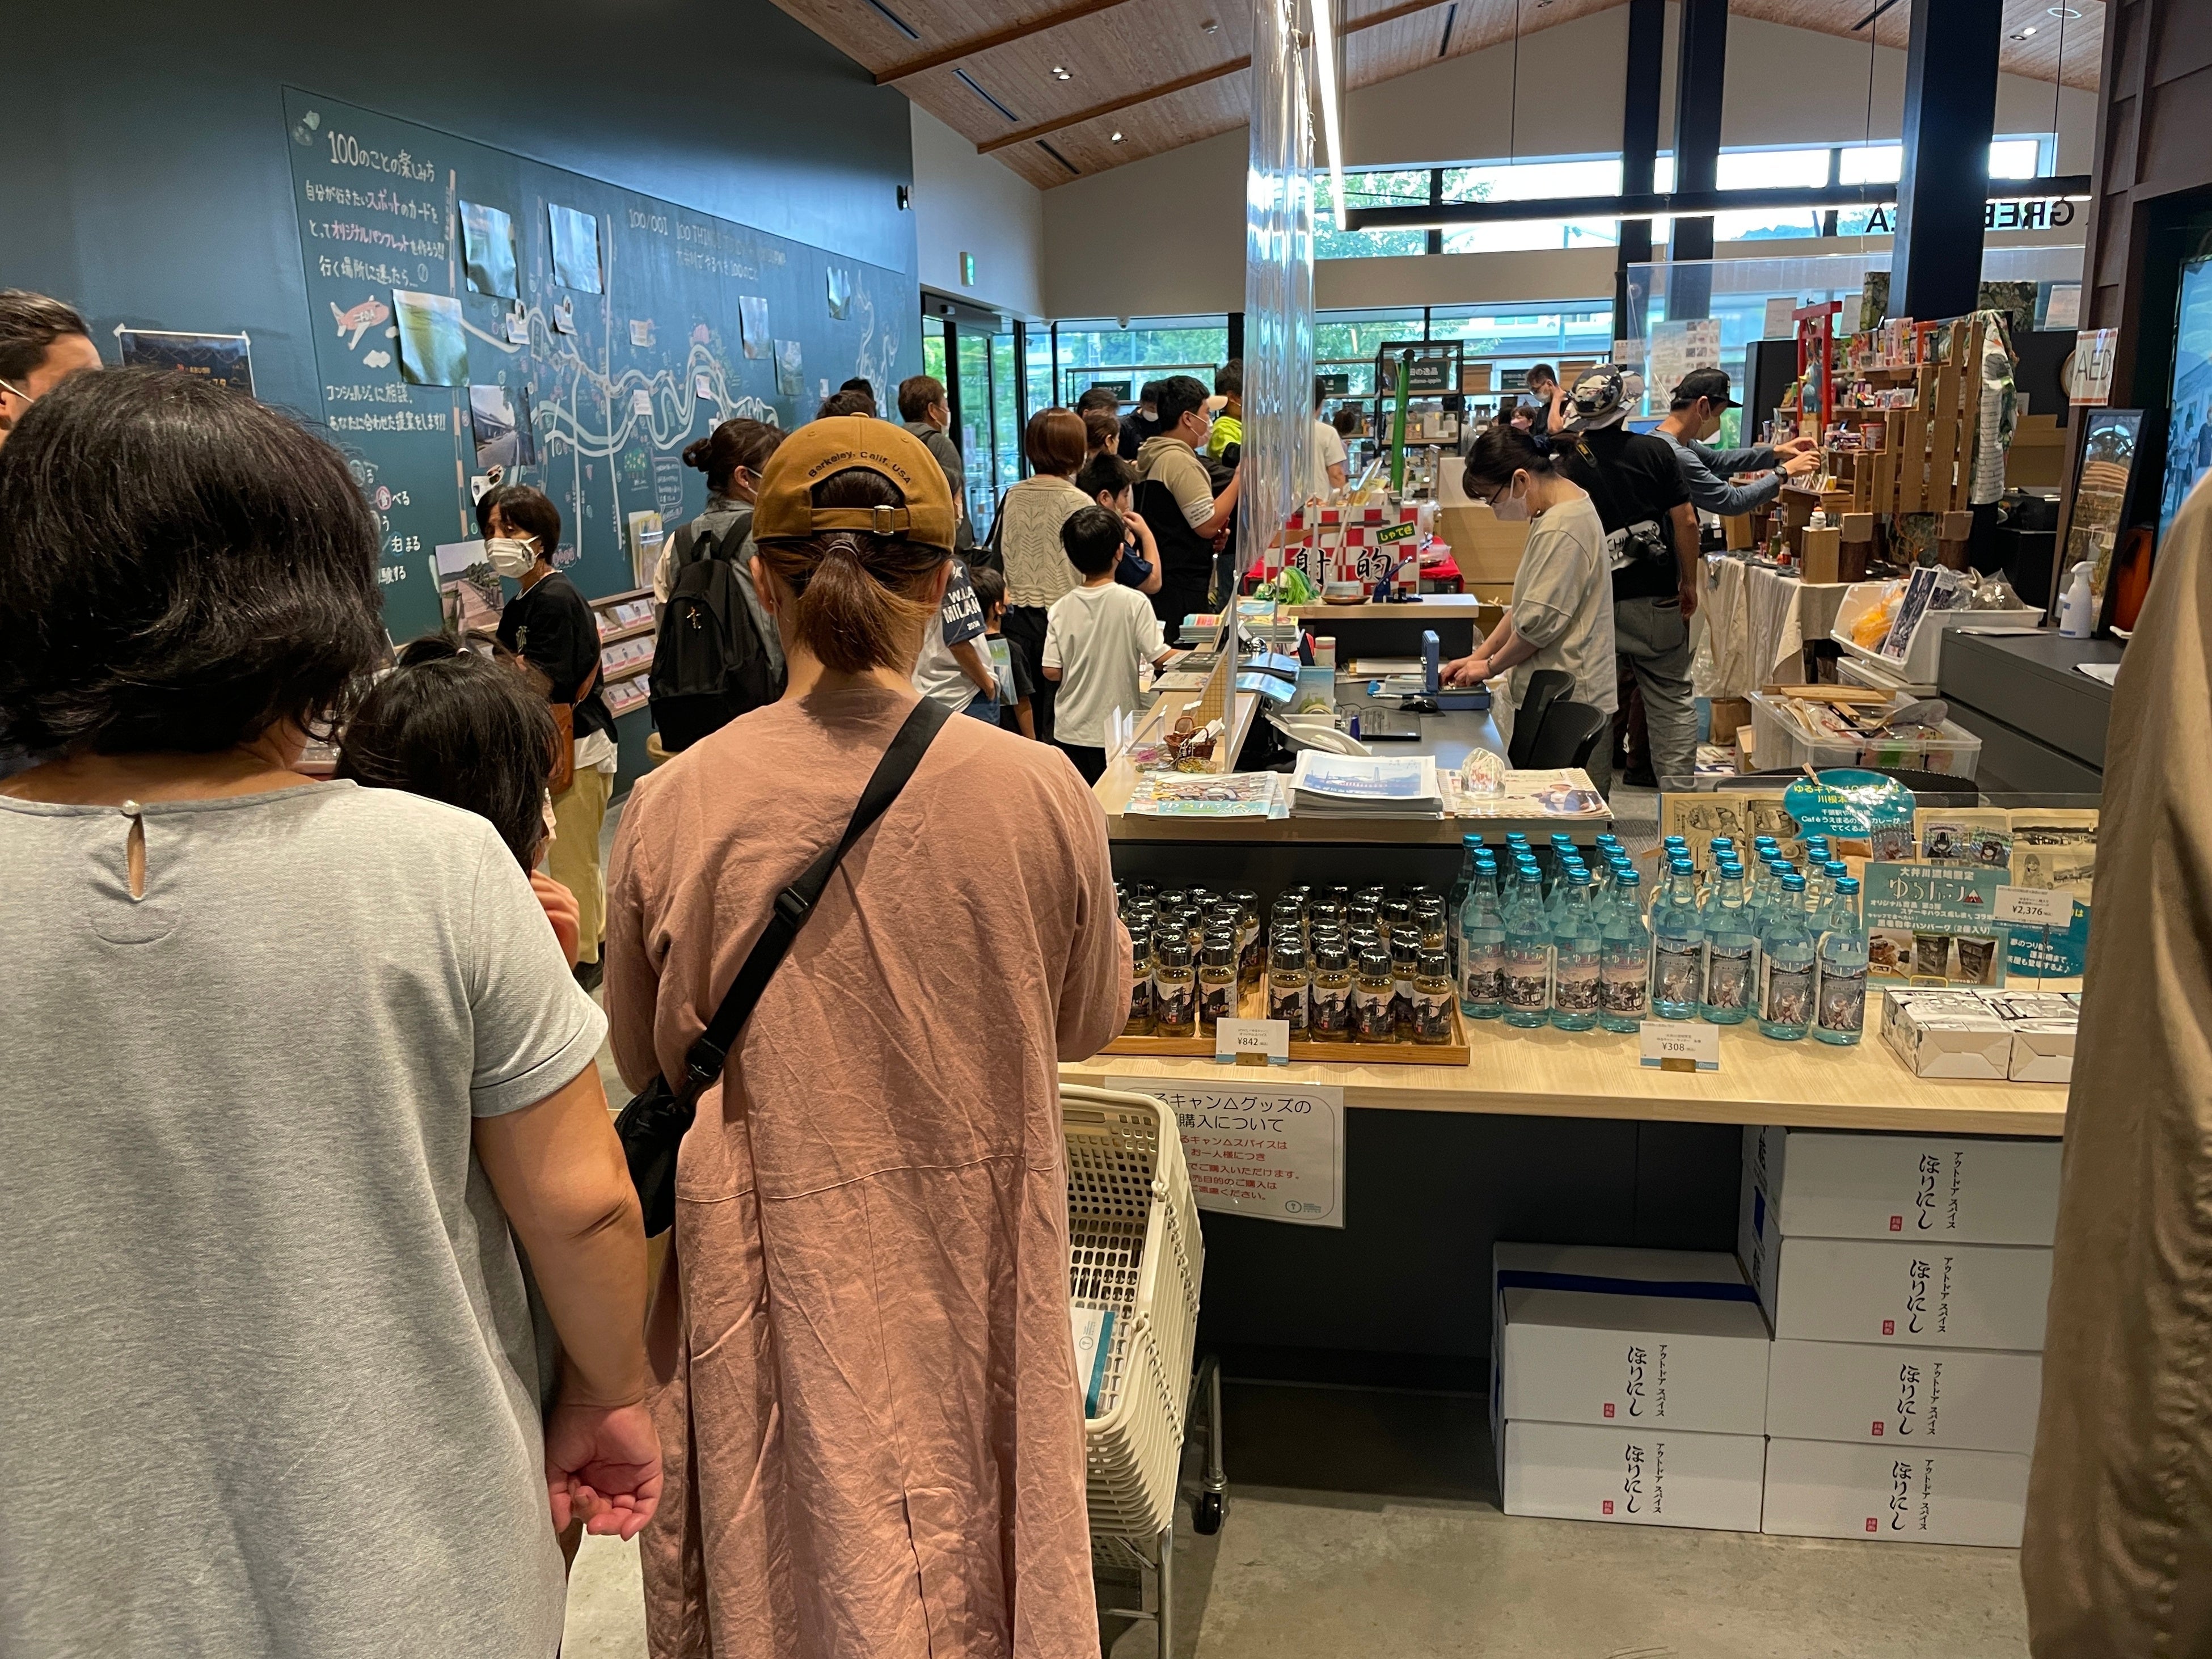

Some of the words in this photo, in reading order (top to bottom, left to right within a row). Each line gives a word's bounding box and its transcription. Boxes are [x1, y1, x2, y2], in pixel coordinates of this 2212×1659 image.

[2075, 349, 2111, 381] AED
[808, 451, 856, 478] Berkeley,
[892, 463, 911, 484] USA
[1379, 525, 1413, 542] しゃてき
[943, 597, 981, 624] MILAN
[2012, 905, 2042, 915] ¥2,376
[1662, 1042, 1685, 1051] ¥308
[1153, 1092, 1311, 1114] るキャン△グッズの
[1177, 1113, 1284, 1133] 購入について
[1180, 1135, 1288, 1150] るキャン△スパイスは
[1191, 1149, 1265, 1162] お一人様につき
[1188, 1163, 1299, 1179] でご購入いただけます。
[1192, 1175, 1277, 1189] 売目的のご購入は
[1916, 1153, 1941, 1230] ほりにし
[1907, 1259, 1931, 1333] ほりにし
[1626, 1345, 1647, 1417] ほりにし
[1897, 1363, 1920, 1435] ほりにし
[1624, 1443, 1645, 1514] ほりにし
[1889, 1460, 1913, 1530] ほりにし
